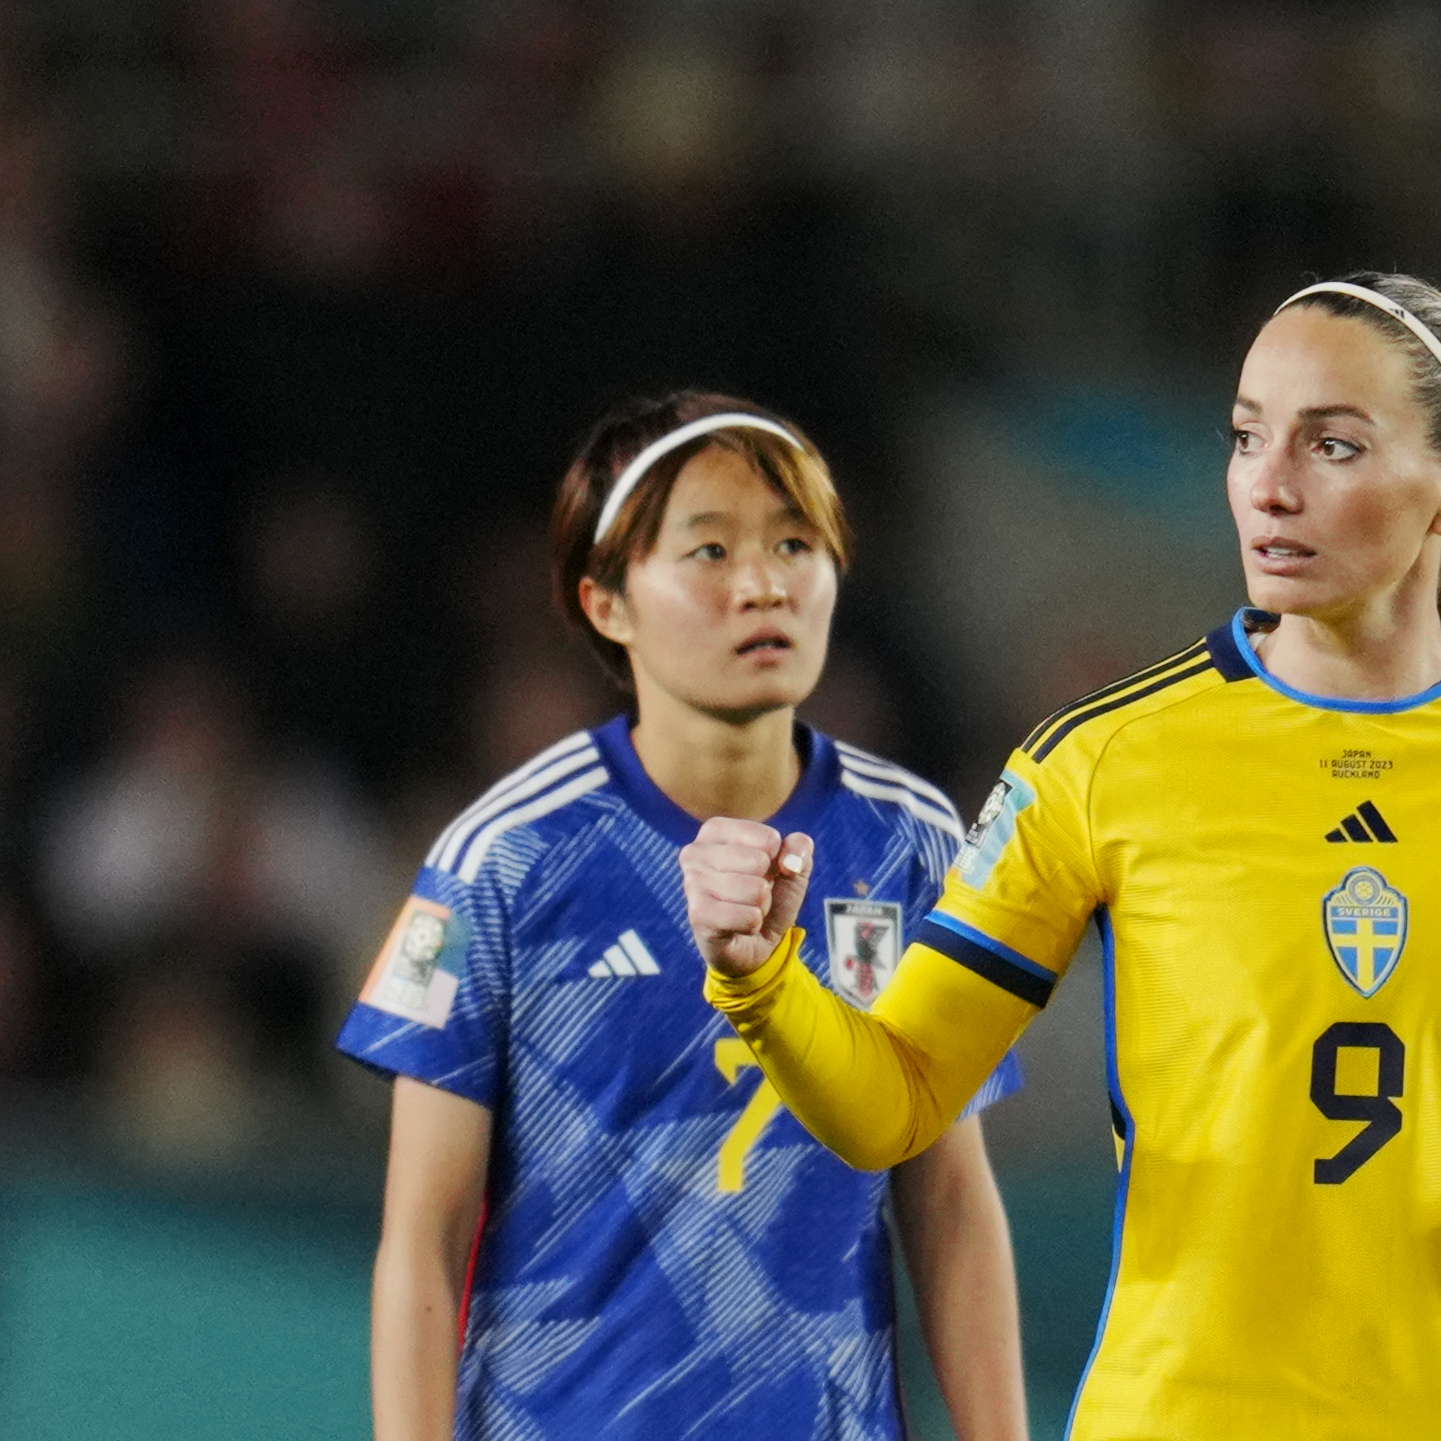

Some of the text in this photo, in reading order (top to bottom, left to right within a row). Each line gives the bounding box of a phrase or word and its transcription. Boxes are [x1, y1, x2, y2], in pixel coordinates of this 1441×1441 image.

[1342, 749, 1372, 759] JAPAN
[1319, 759, 1394, 770] 11 AUGUST 2023
[1332, 769, 1381, 779] AUCKLAND
[1337, 907, 1391, 917] SVERIGE
[1310, 1021, 1406, 1185] 9
[714, 1037, 784, 1194] 7
